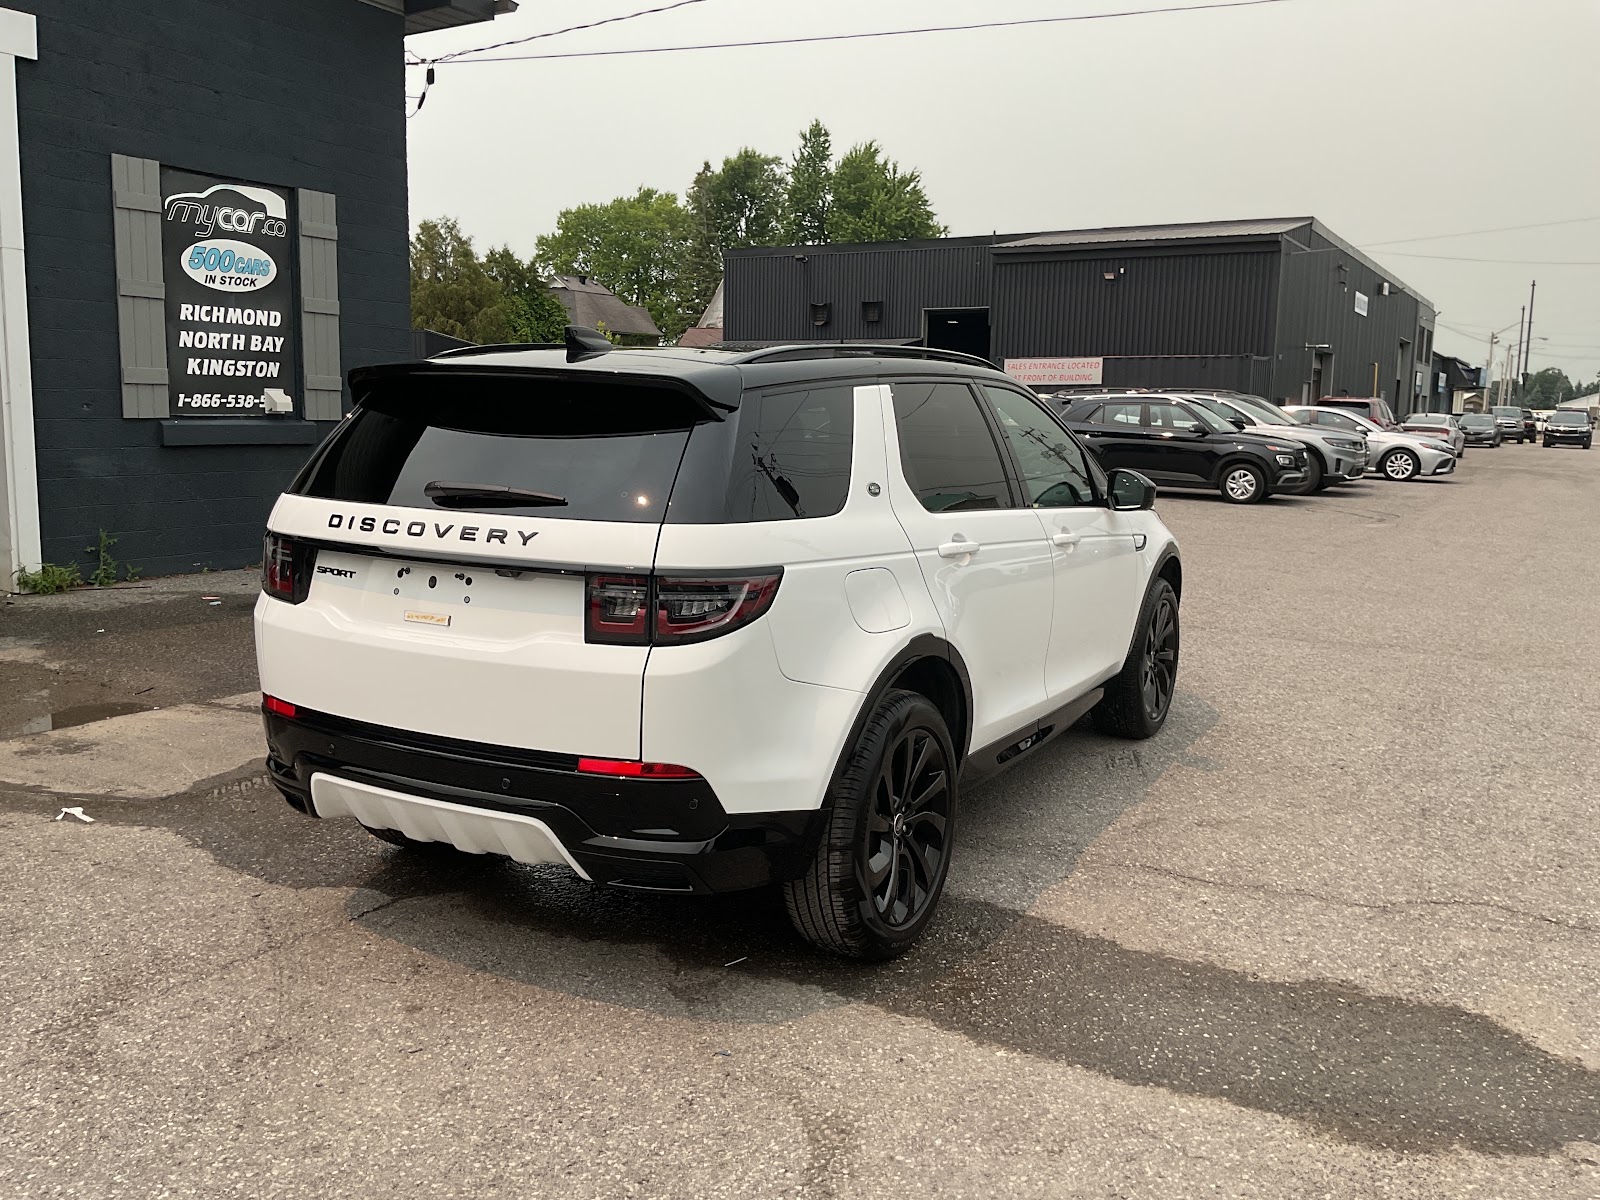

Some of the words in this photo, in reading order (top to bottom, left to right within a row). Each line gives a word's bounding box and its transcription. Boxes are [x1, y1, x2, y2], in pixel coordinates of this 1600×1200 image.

[234, 256, 271, 277] CARS
[204, 274, 217, 285] IN
[219, 275, 258, 288] STOCK
[179, 303, 282, 328] RICHMOND
[178, 330, 246, 351] NORTH
[250, 334, 285, 353] BAY
[186, 358, 281, 378] KINGSTON
[1007, 362, 1027, 371] SALES
[1028, 362, 1066, 370] ENTRANCE
[1067, 361, 1100, 370] LOCATED
[1023, 374, 1046, 382] FRONT
[1047, 374, 1058, 382] OF
[1059, 373, 1093, 381] BUILDING
[177, 393, 266, 409] 1-866-538-5
[328, 513, 539, 546] DISCOVERY
[316, 565, 357, 579] SPORT
